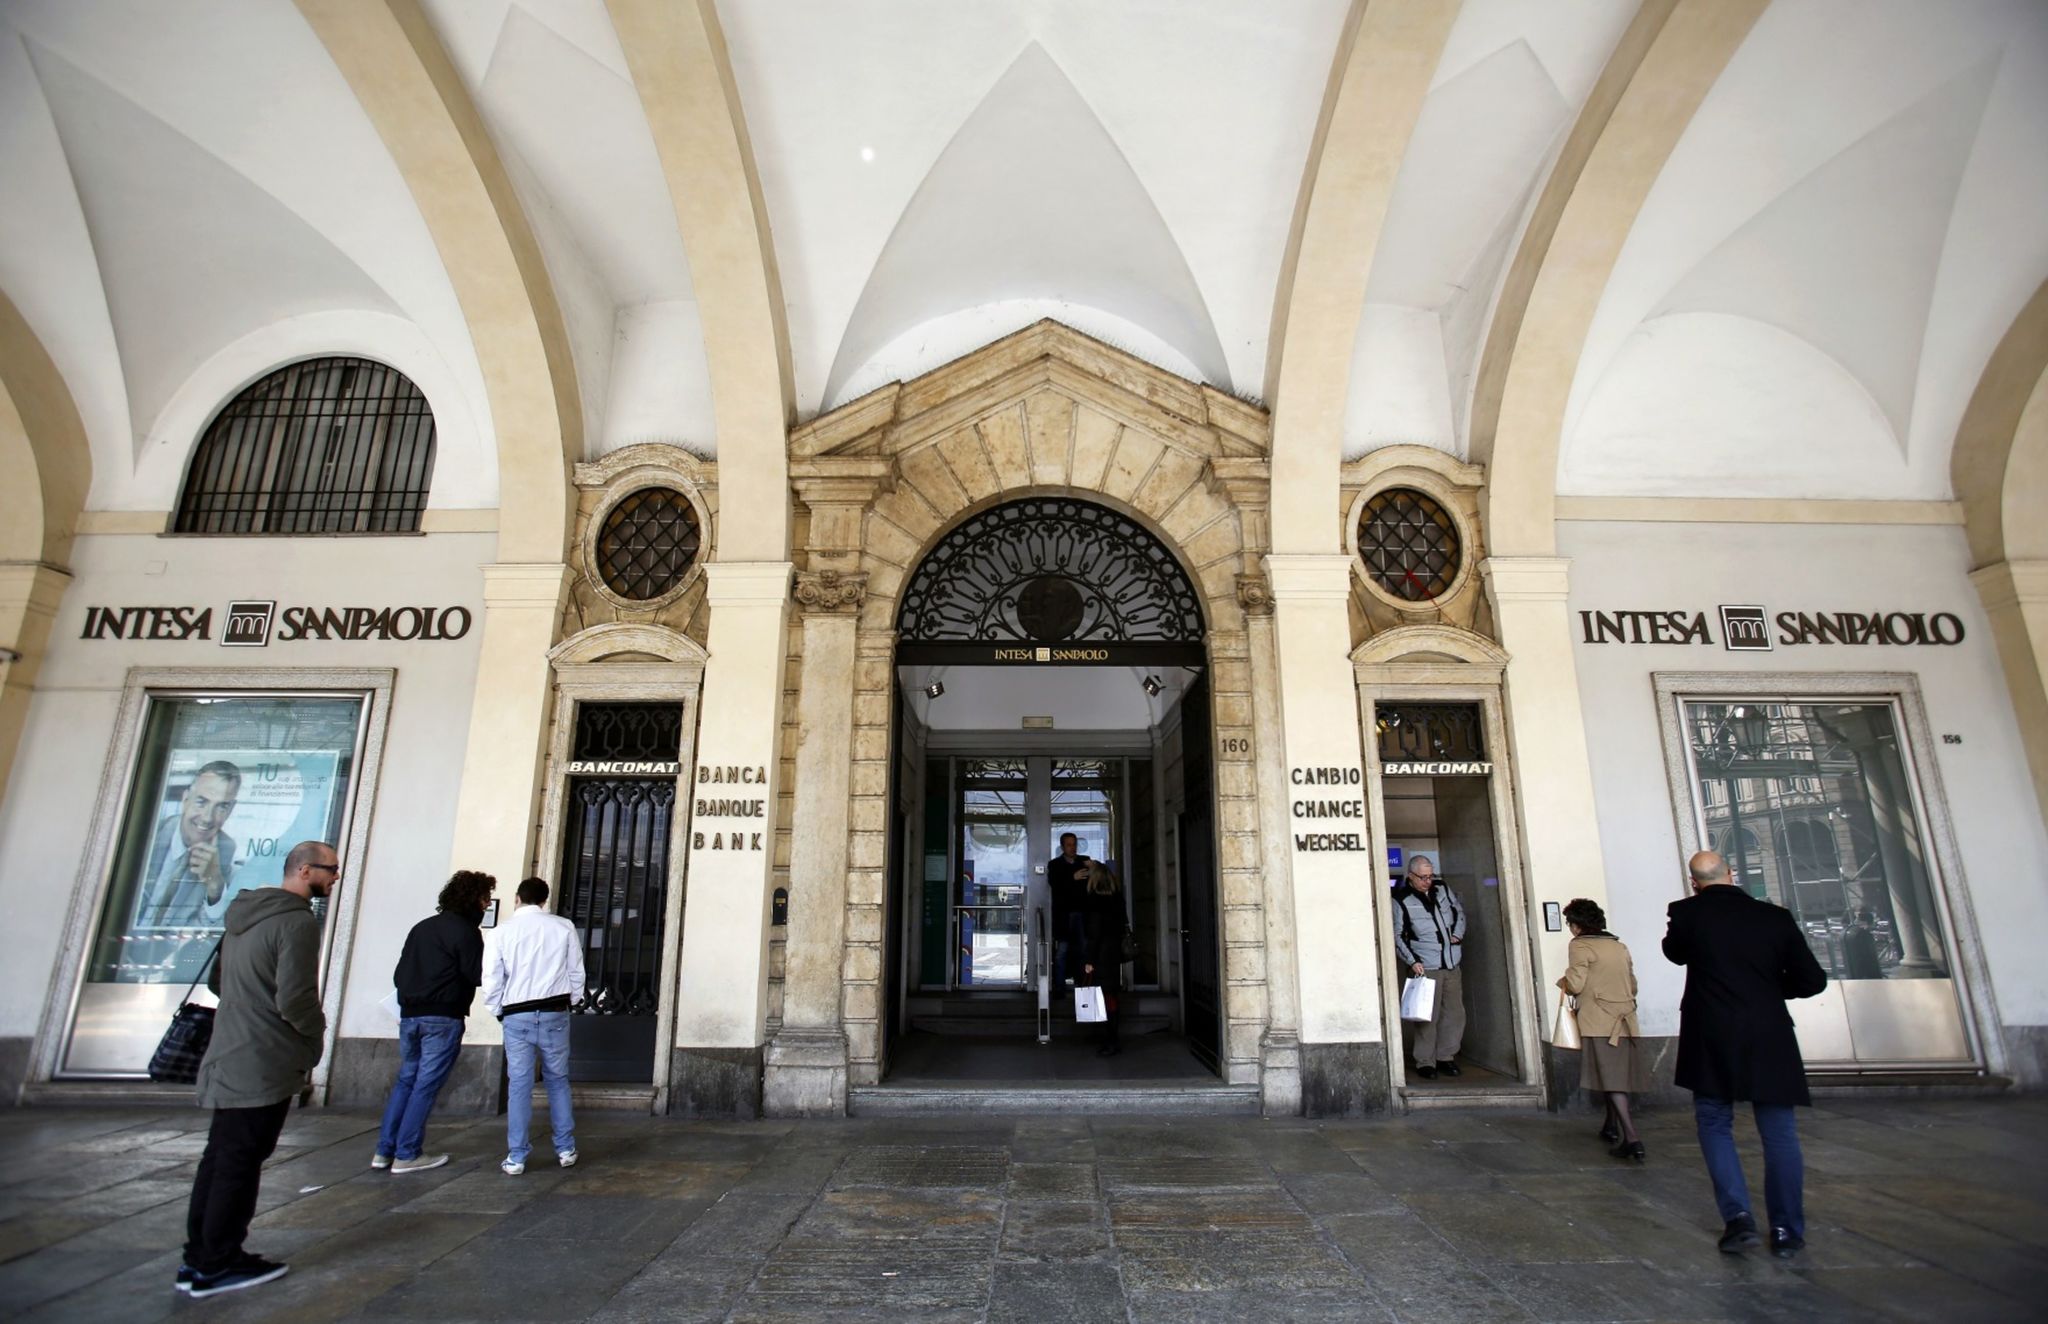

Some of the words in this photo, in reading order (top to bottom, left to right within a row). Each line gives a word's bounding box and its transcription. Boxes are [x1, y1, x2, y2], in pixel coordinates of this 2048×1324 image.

[80, 606, 213, 640] INTESA
[278, 606, 472, 641] SANPAOLO
[1578, 610, 1714, 645] INTESA
[1776, 611, 1966, 646] SANPAOLO
[994, 649, 1033, 660] INTESA
[1052, 649, 1109, 660] SANPAOLO
[1221, 738, 1249, 753] 160
[257, 763, 280, 782] TU
[569, 761, 679, 773] BANCOMAT
[698, 766, 766, 784] BANCA
[1291, 767, 1361, 785] CAMBIO
[1385, 762, 1494, 775] BANCOMAT
[695, 799, 764, 818] BANQUE
[1293, 801, 1363, 818] CHANGE
[246, 838, 279, 857] NOI
[693, 832, 762, 850] BANK
[1295, 834, 1366, 852] WECHSEL
